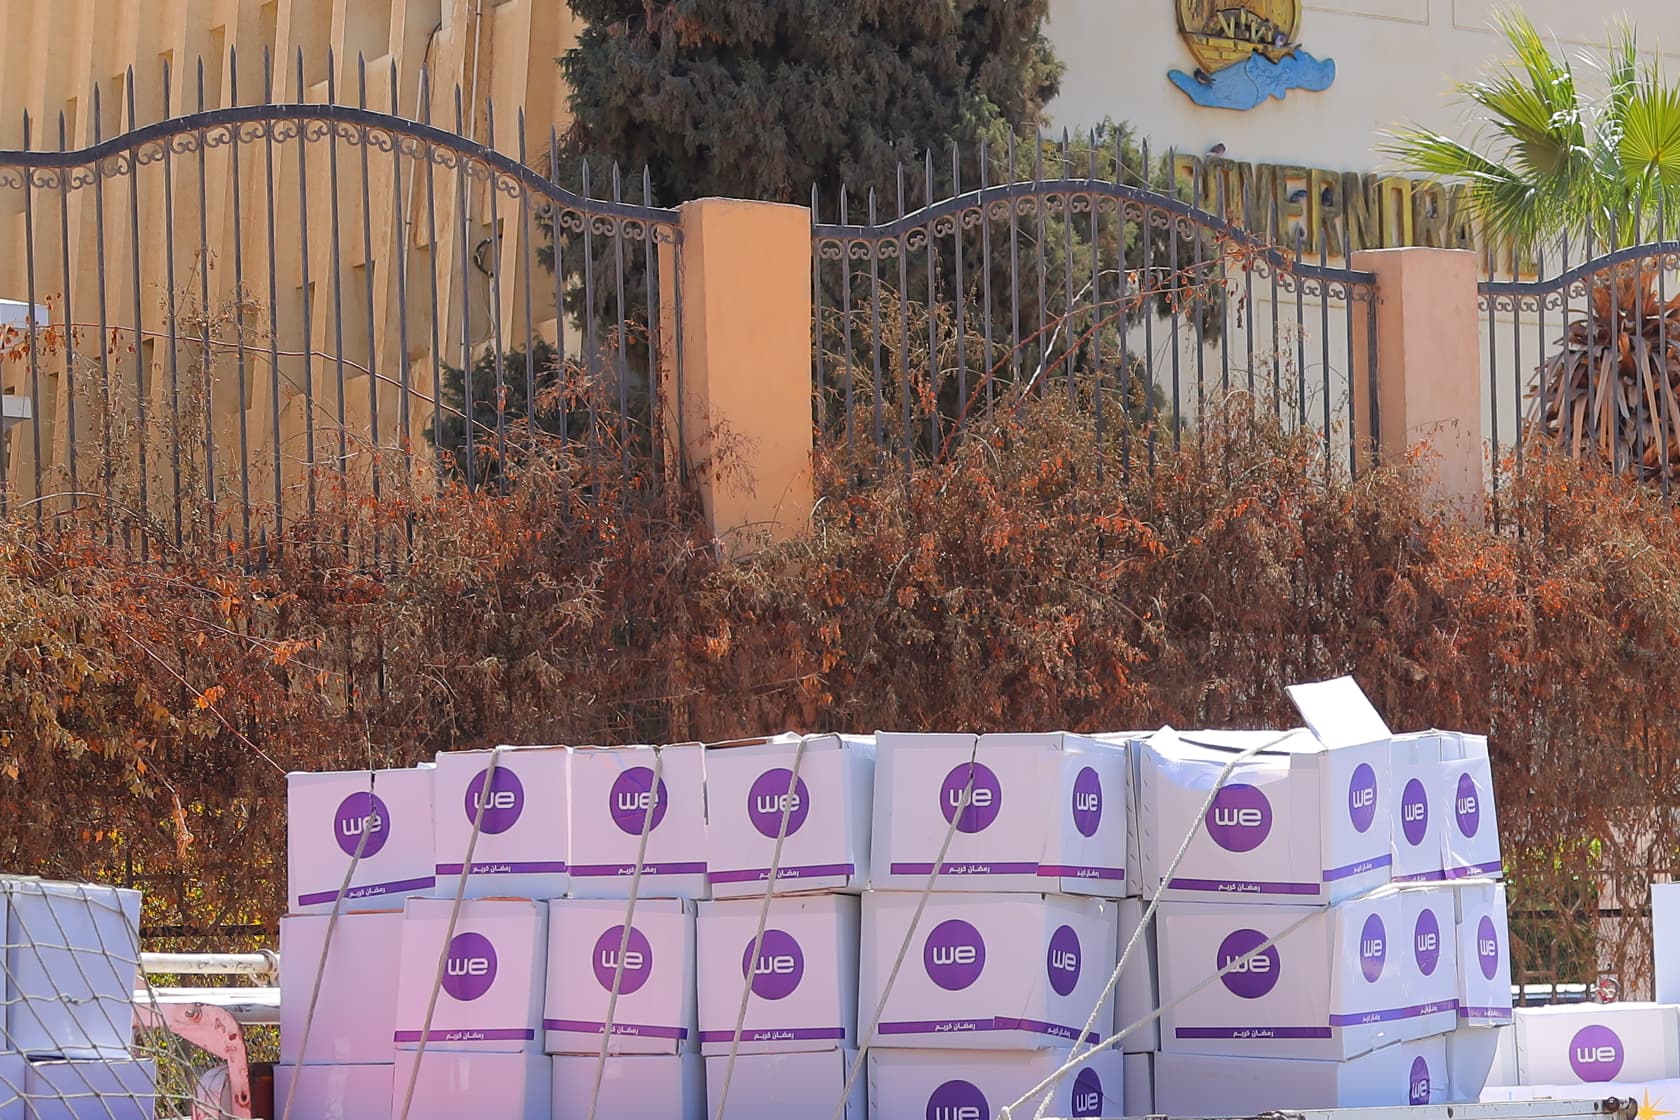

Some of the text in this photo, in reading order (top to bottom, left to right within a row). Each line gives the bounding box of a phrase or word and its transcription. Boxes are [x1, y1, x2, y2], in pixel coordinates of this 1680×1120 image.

[473, 791, 516, 809] we
[757, 793, 800, 813] we
[949, 788, 992, 807] we
[1076, 792, 1098, 811] we
[1352, 788, 1374, 808] we
[1458, 796, 1476, 815] we
[1214, 807, 1262, 827] we
[1404, 803, 1424, 821] we
[1363, 939, 1383, 957] we
[1417, 933, 1437, 951] we
[1480, 939, 1496, 956] we
[601, 949, 644, 969] we
[933, 945, 976, 964] we
[1052, 949, 1077, 971] we
[447, 957, 489, 975] we
[753, 955, 794, 974] we
[1577, 1046, 1616, 1063] we
[1412, 1079, 1428, 1099] we
[1076, 1092, 1099, 1112] we
